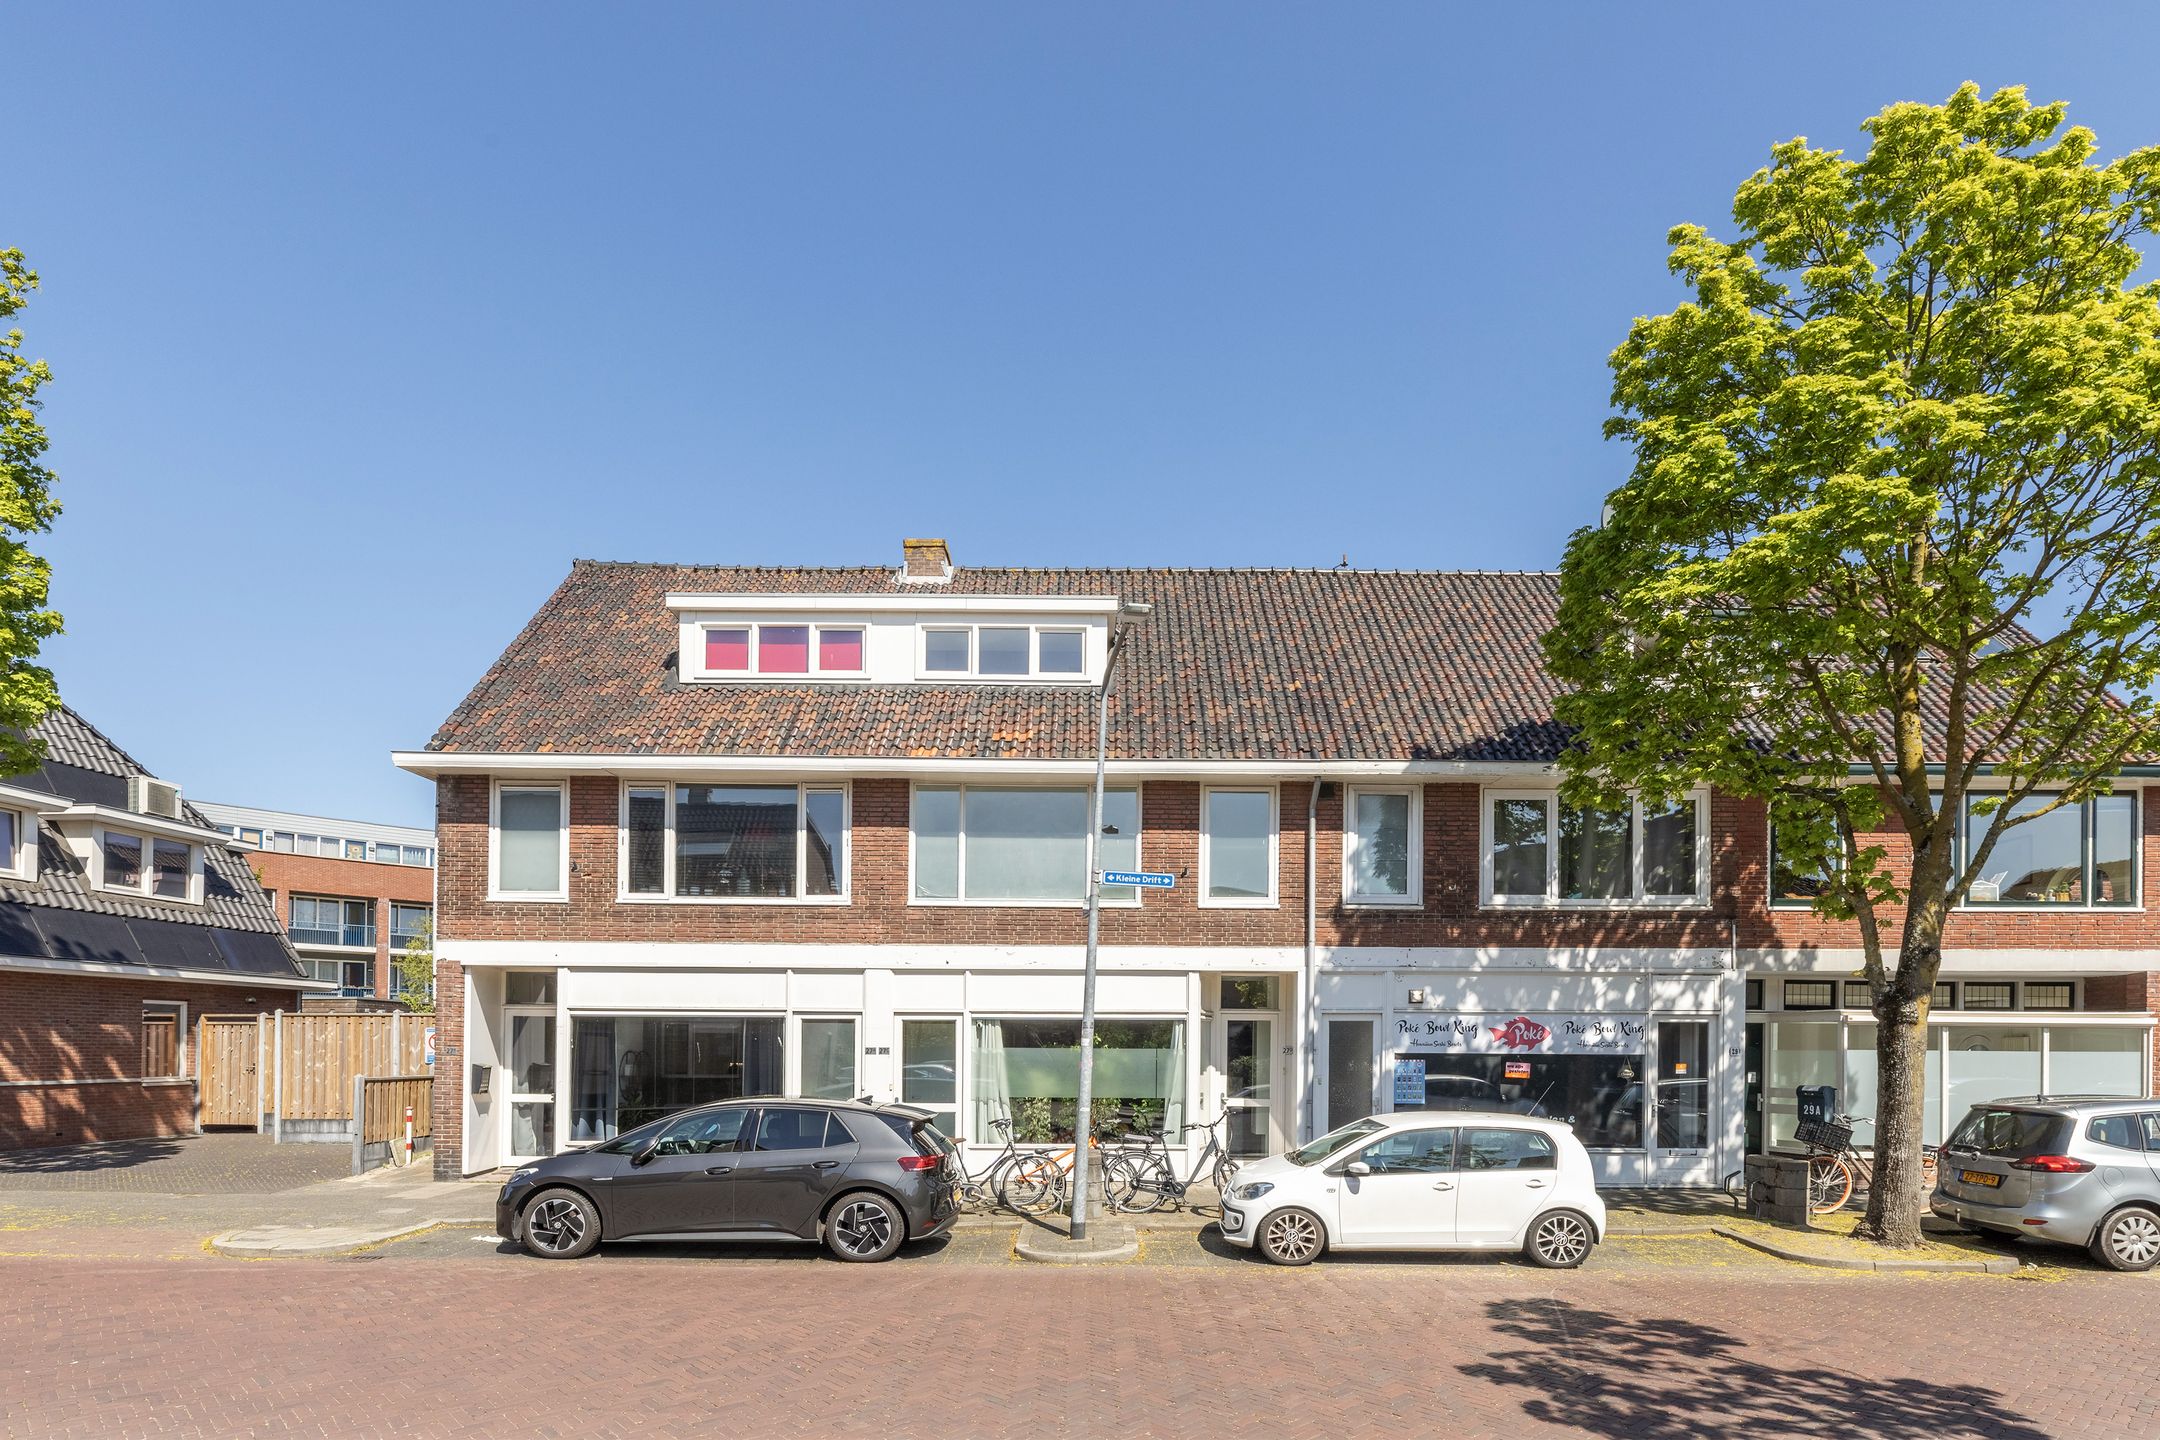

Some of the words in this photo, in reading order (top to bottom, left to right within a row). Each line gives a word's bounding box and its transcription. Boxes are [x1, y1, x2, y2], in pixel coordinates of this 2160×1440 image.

[1116, 874, 1141, 883] Kleine
[1142, 875, 1162, 884] Drift
[1395, 1020, 1420, 1034] Poké
[1423, 1020, 1450, 1035] Bowl
[1453, 1020, 1479, 1039] King
[1509, 1022, 1544, 1044] Poké
[1562, 1020, 1586, 1035] Poké
[1590, 1021, 1617, 1036] Bowl
[1620, 1021, 1644, 1040] King
[1803, 1104, 1821, 1115] 29A
